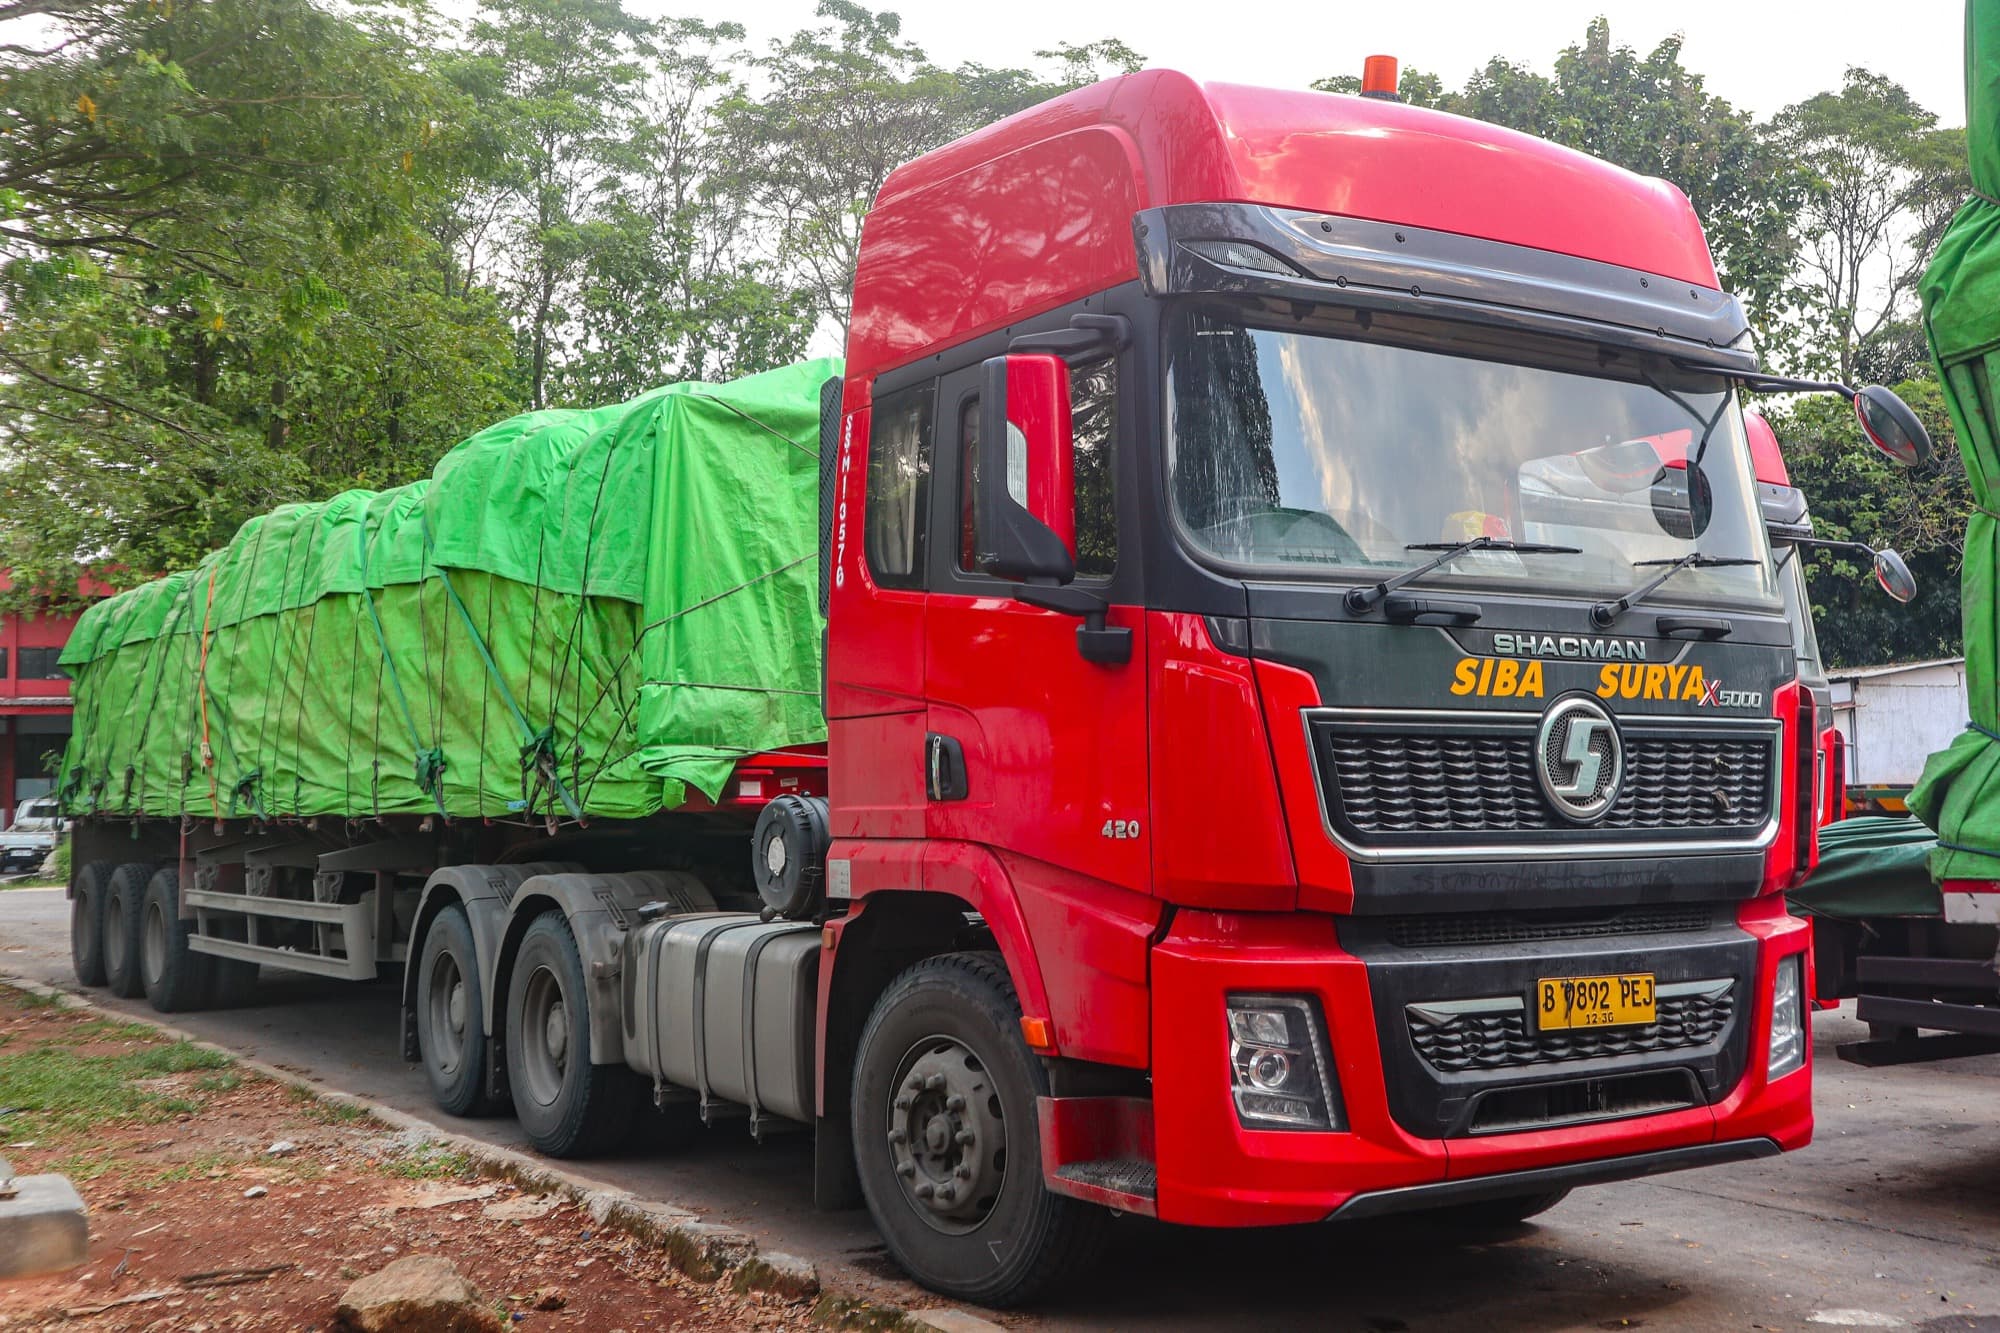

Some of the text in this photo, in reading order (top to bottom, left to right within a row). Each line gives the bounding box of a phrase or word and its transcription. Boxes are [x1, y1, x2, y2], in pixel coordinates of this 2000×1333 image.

[1494, 633, 1646, 660] SHACMAN
[1450, 658, 1705, 701] SIBA SURYA
[1698, 679, 1762, 708] X5000
[1101, 819, 1139, 839] 420
[1543, 979, 1653, 1013] B 9892 PEJ
